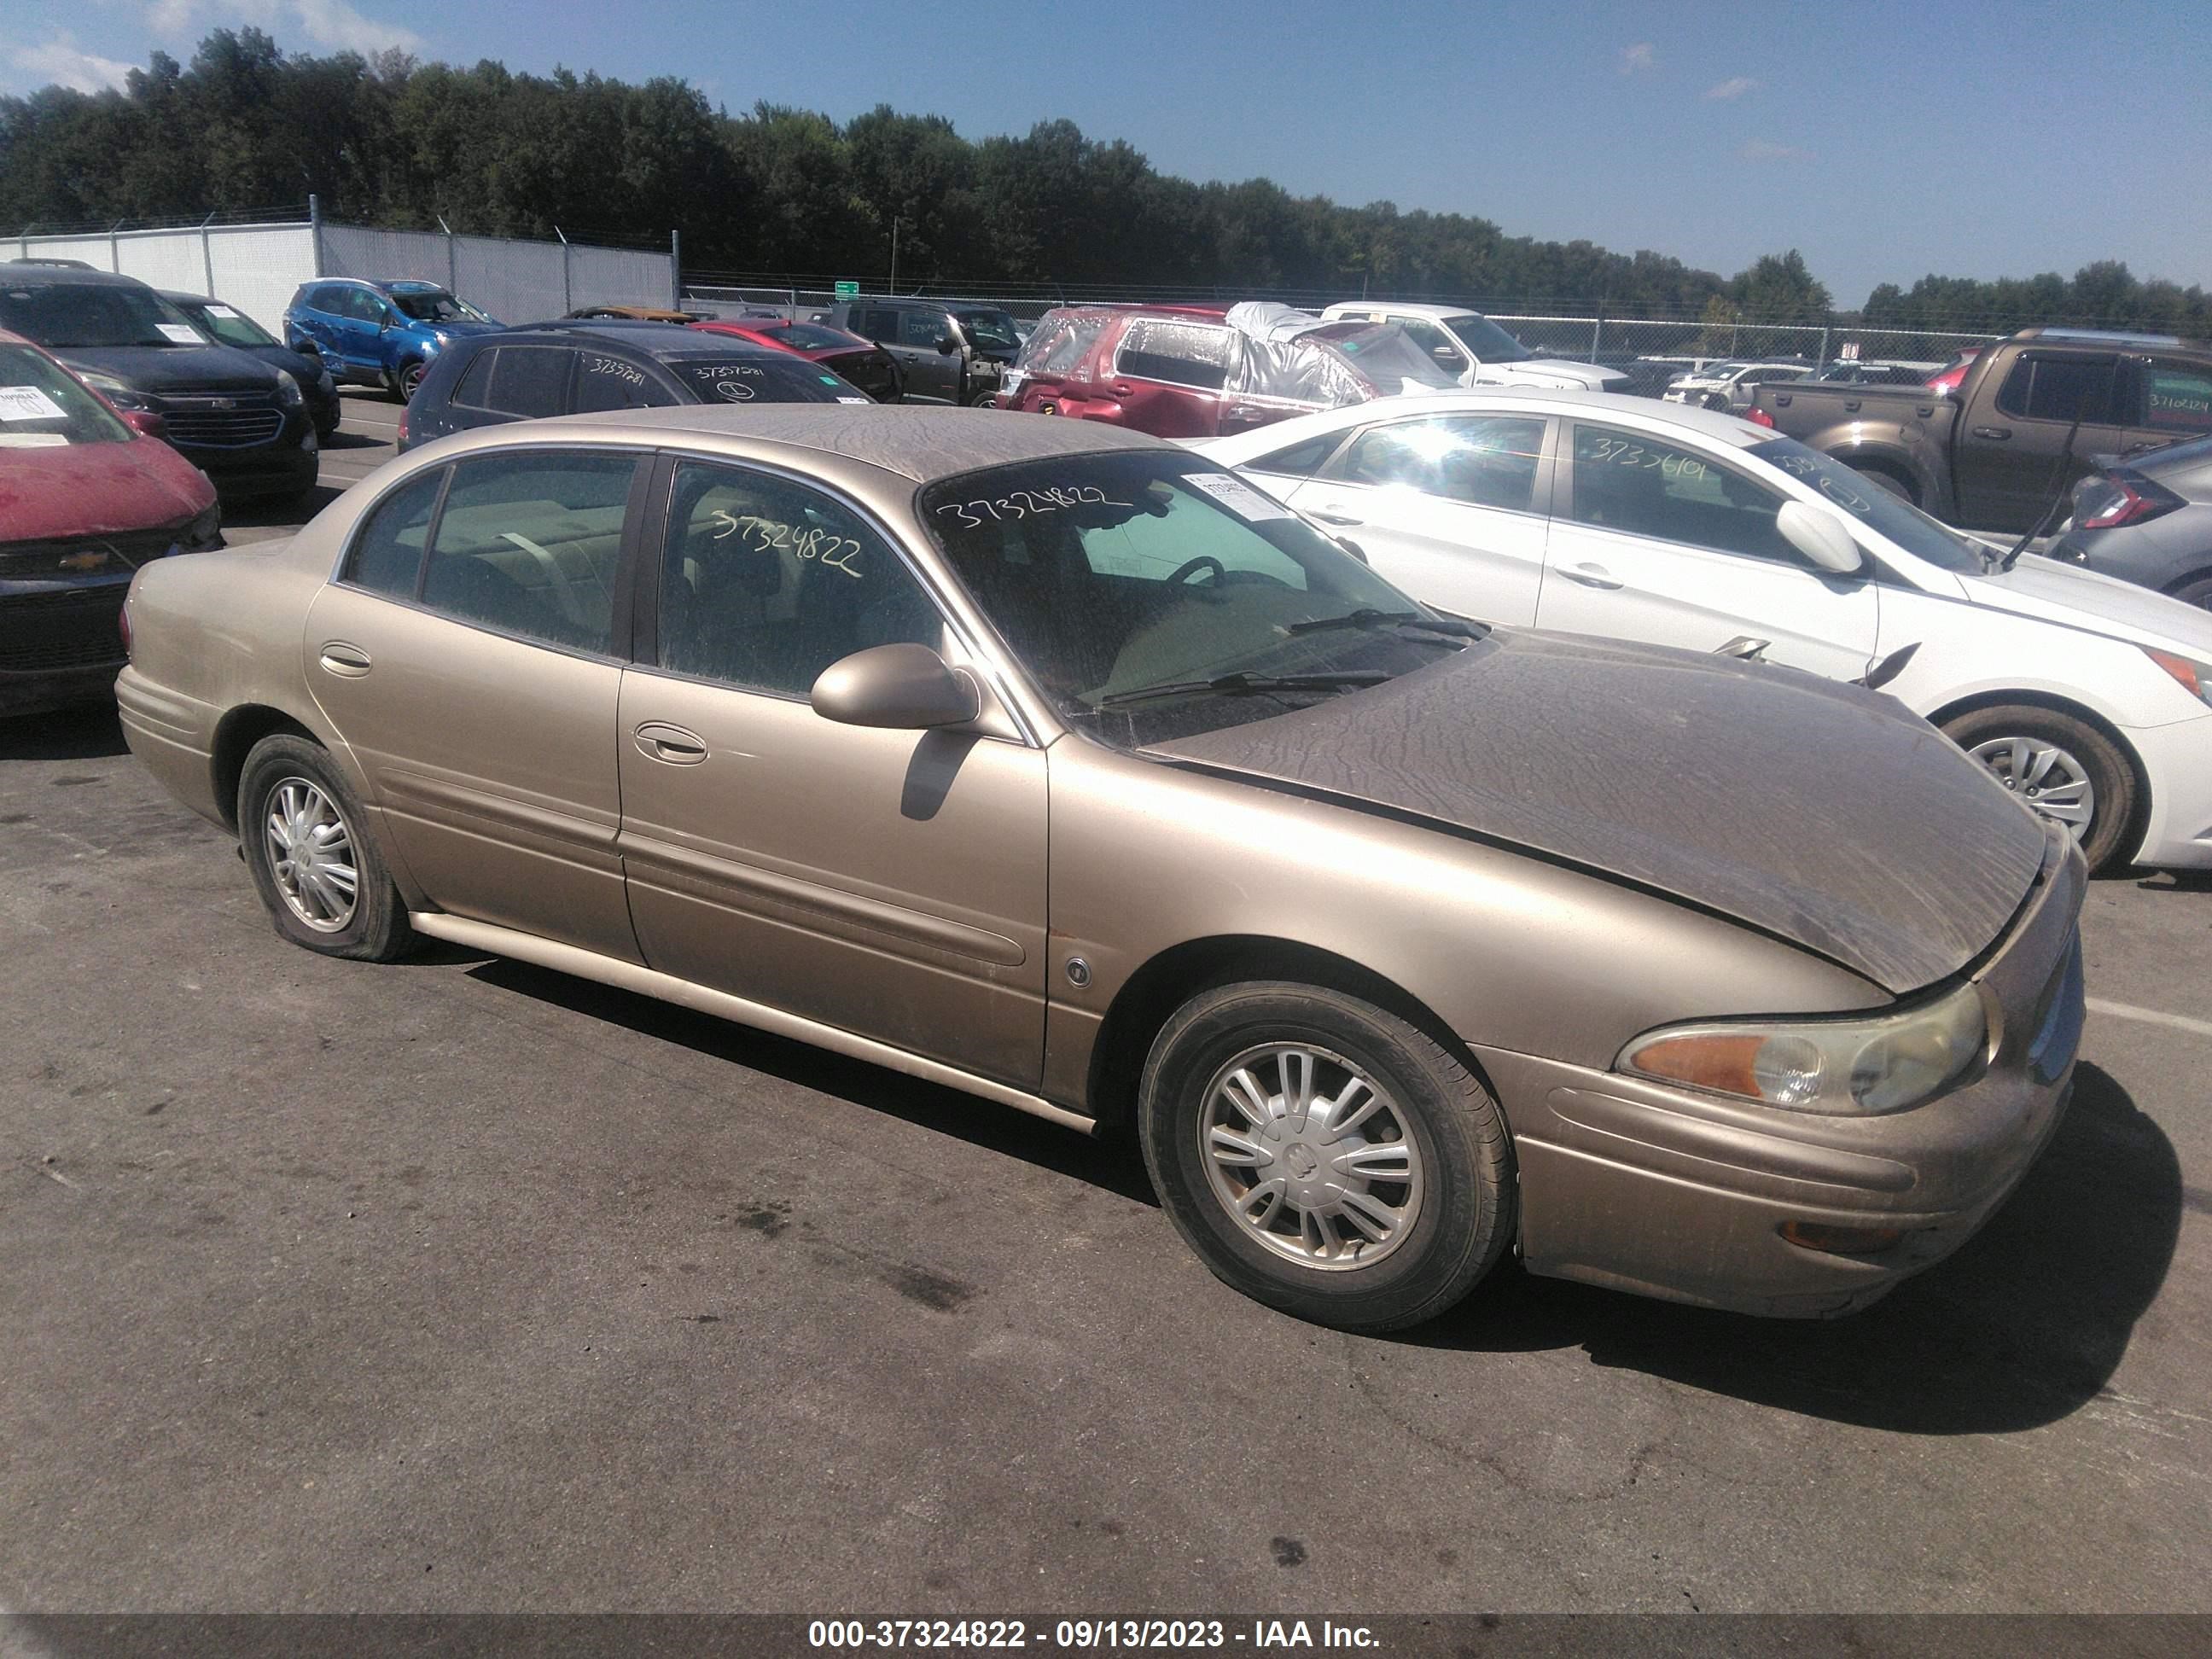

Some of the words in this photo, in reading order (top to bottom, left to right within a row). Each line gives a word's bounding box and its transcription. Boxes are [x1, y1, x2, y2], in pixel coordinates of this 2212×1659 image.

[590, 358, 646, 387] 37357281
[693, 365, 764, 379] 37357281
[936, 487, 1134, 528] 37324822
[711, 509, 863, 578] 37324822
